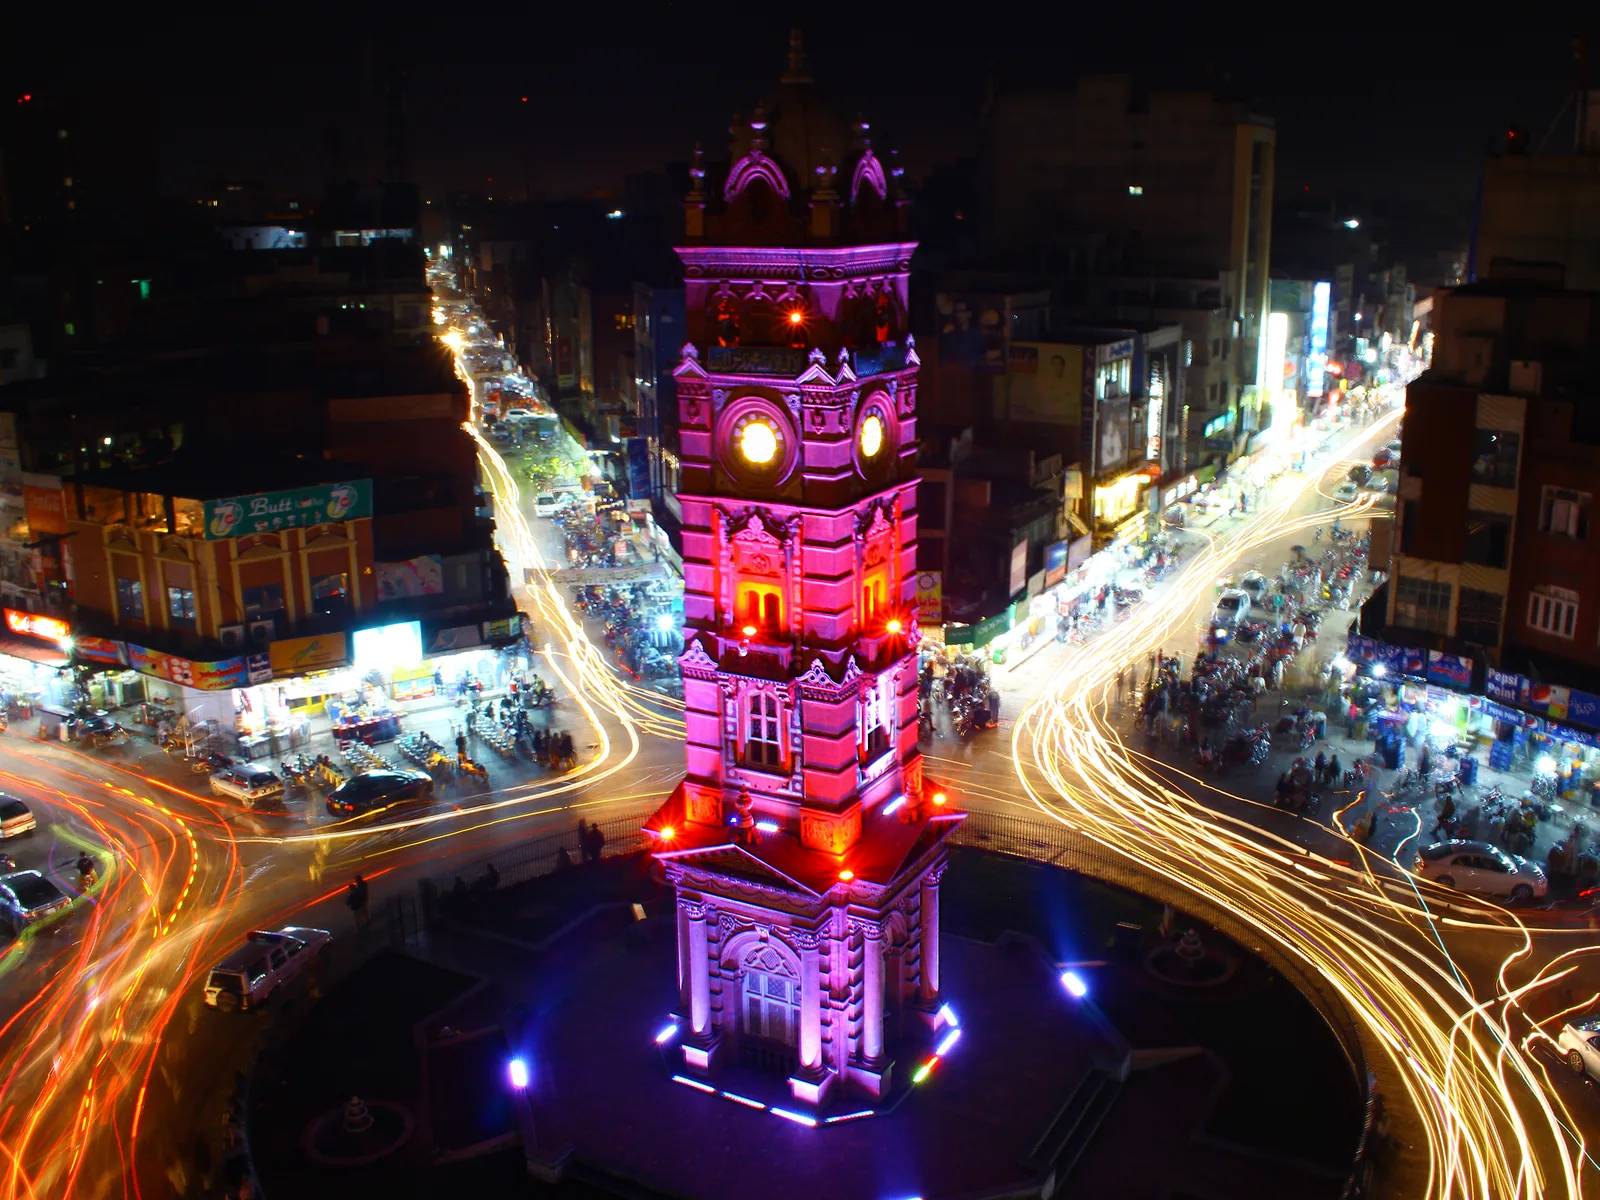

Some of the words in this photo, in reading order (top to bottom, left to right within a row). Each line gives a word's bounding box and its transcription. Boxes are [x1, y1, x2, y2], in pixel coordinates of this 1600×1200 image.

[248, 497, 293, 517] Butt
[1488, 667, 1518, 688] Pepsi
[1487, 682, 1516, 701] Point
